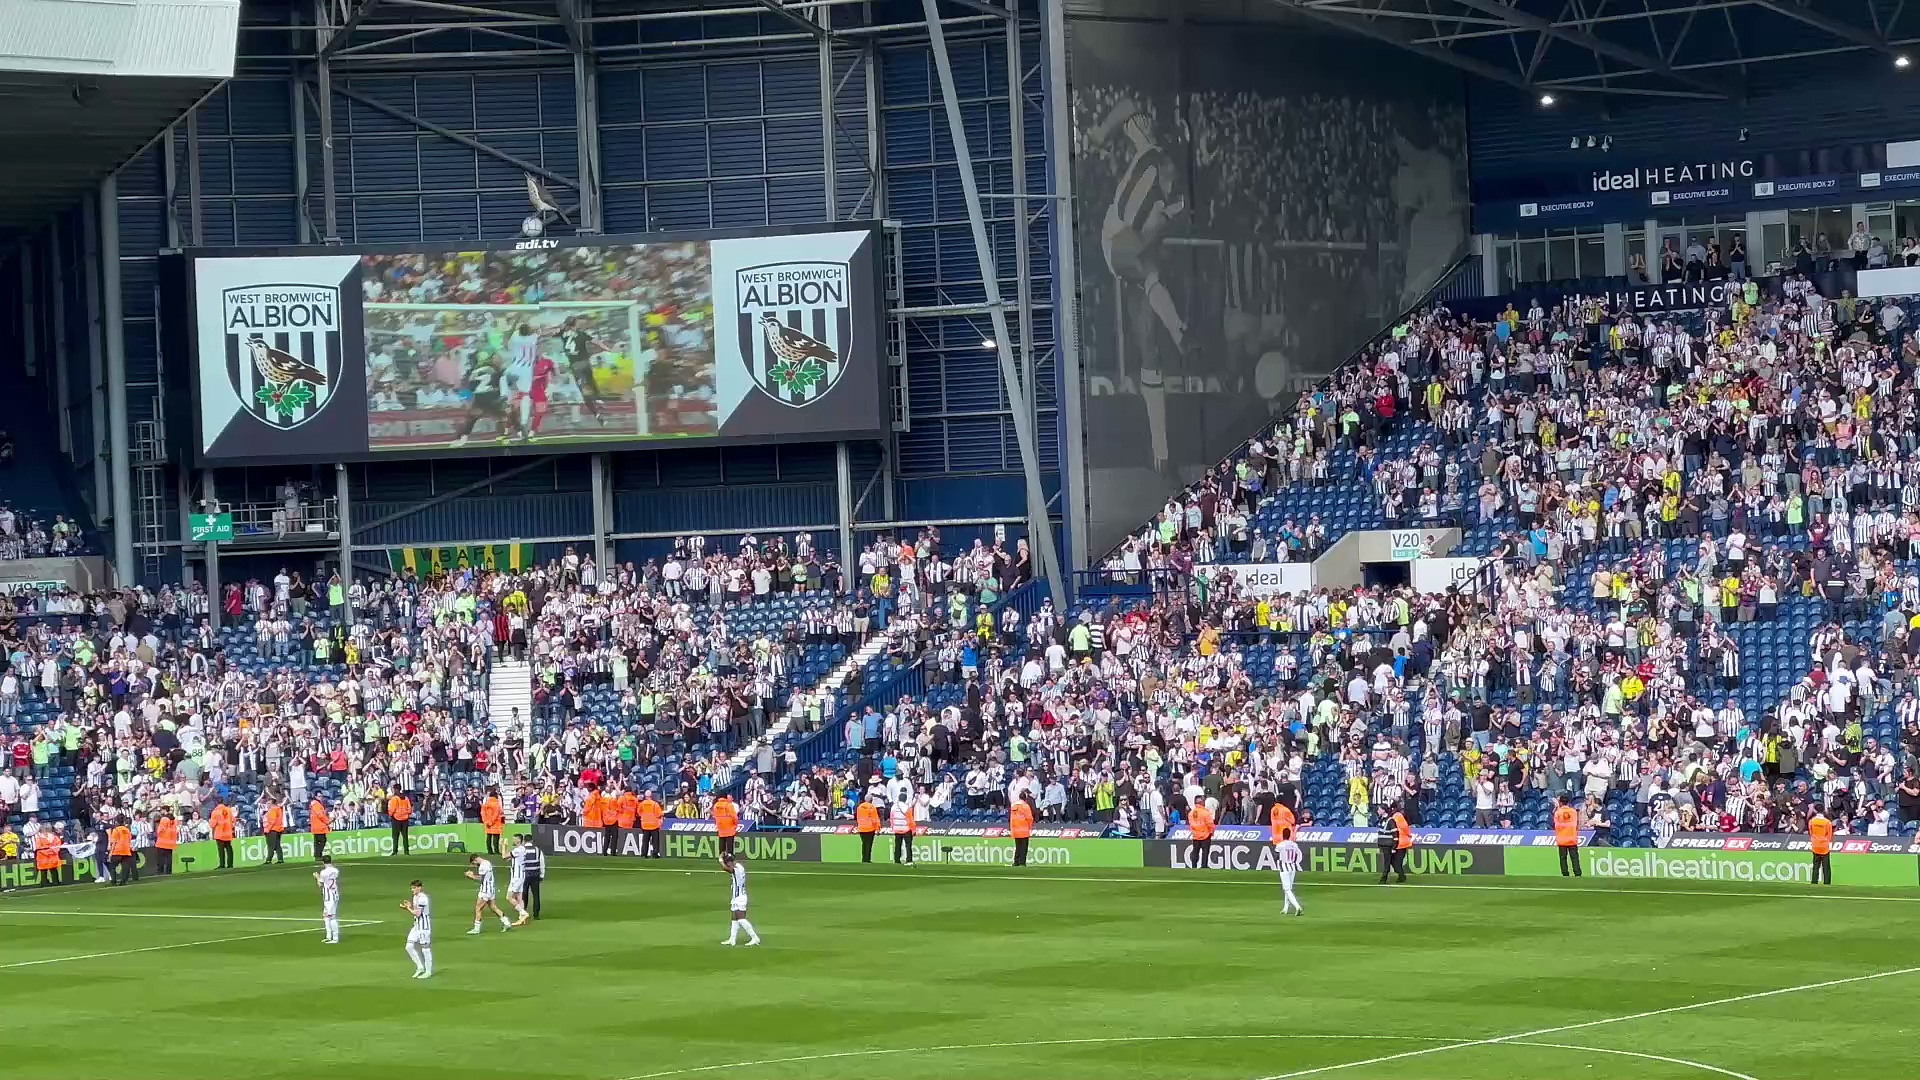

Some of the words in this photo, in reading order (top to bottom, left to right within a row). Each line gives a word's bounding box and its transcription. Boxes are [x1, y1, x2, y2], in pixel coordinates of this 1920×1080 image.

[1593, 168, 1639, 191] ideal
[1646, 161, 1754, 185] HEATING
[1885, 173, 1920, 181] EXECUTIVE
[1673, 191, 1705, 200] EXECUTIVE
[1707, 189, 1719, 197] BOX
[1778, 183, 1811, 191] EXECUTIVE
[1541, 203, 1572, 211] EXECUTIVE
[515, 239, 559, 250] adi.tv
[742, 272, 774, 284] WEST
[778, 268, 842, 282] BROMWICH
[228, 294, 260, 303] WEST
[264, 292, 331, 303] BROMWICH
[742, 280, 842, 308] ALBION
[1617, 286, 1724, 308] HEATING
[229, 304, 332, 328] ALBION
[217, 525, 230, 533] AID
[1392, 533, 1419, 548] V20
[1246, 568, 1283, 585] ideal
[1451, 562, 1476, 579] ide
[1030, 829, 1061, 837] PREAD
[666, 834, 719, 859] HEAT
[1750, 840, 1781, 850] Sports
[1869, 843, 1902, 852] Sports
[1310, 847, 1381, 873] HEAT
[1403, 848, 1473, 875] UMP
[1589, 850, 1817, 882] idealheating.com
